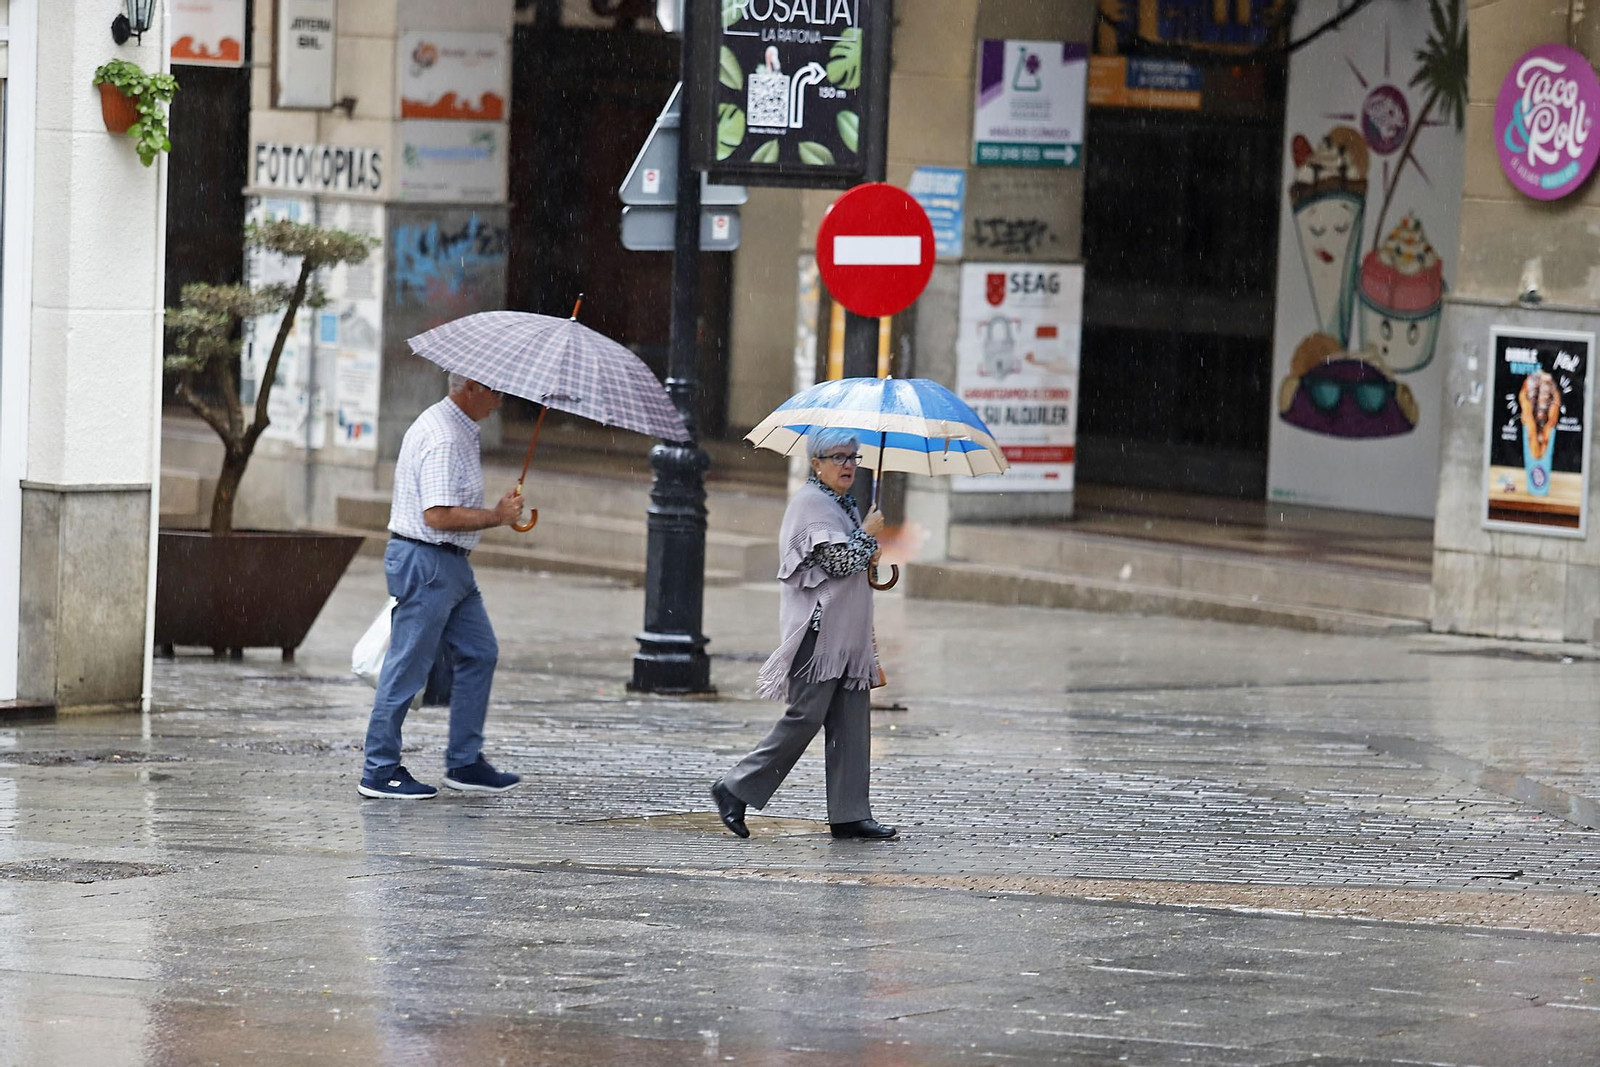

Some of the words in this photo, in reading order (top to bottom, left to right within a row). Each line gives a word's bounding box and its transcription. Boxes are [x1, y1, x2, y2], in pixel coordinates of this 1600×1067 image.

[762, 28, 775, 42] LA
[777, 28, 822, 44] RATONA
[1516, 57, 1578, 113] Taco
[1525, 101, 1589, 167] Roll
[255, 145, 382, 190] FOTOCOPIAS
[1010, 272, 1060, 294] SEAG
[1005, 405, 1069, 426] ALQUILER
